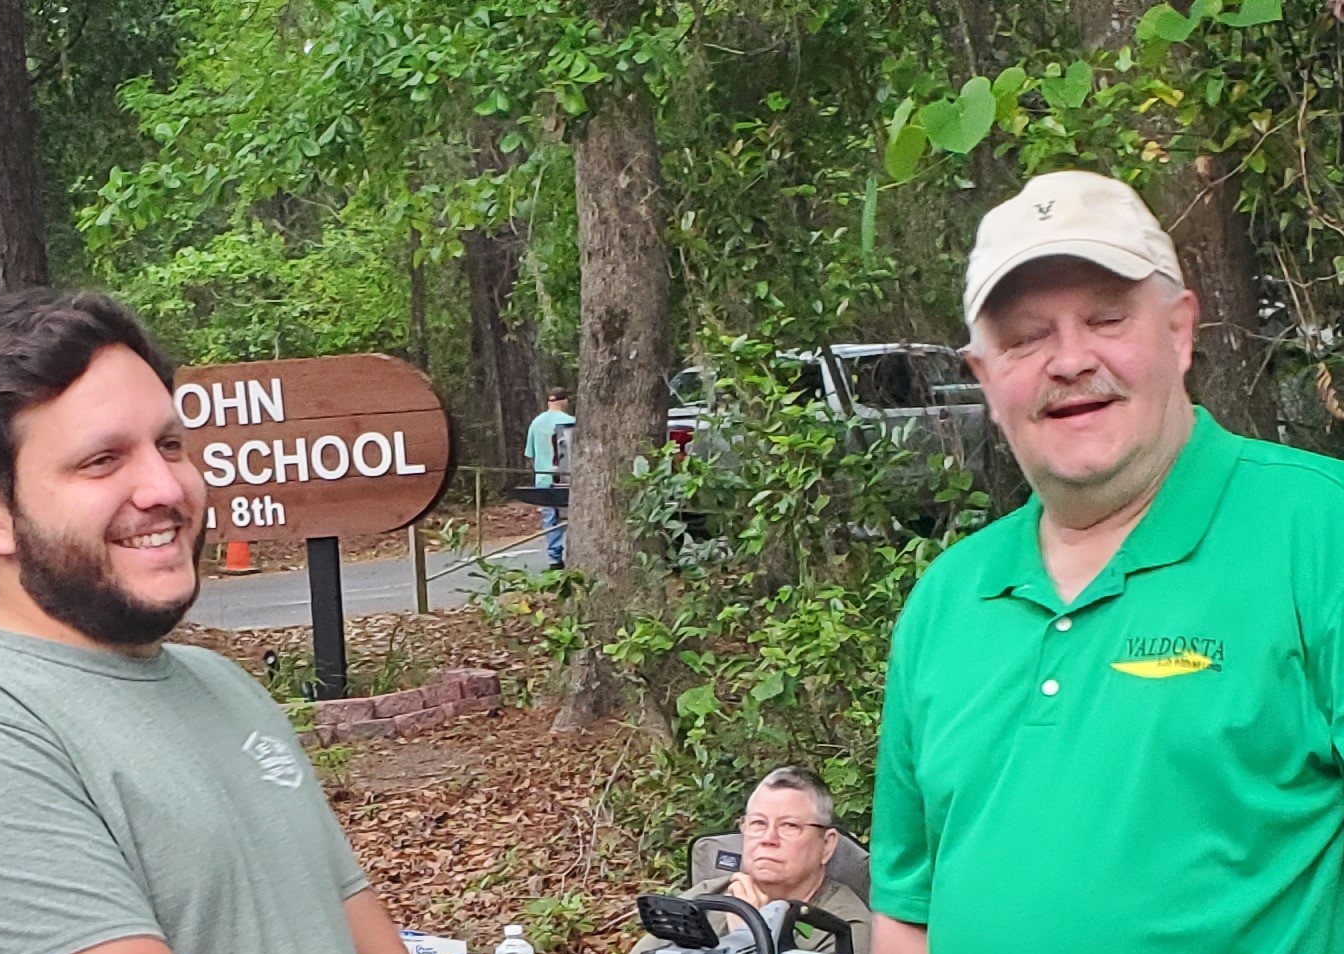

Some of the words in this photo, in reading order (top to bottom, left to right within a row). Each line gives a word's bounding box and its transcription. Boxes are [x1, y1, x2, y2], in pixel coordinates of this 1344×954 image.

[174, 378, 286, 429] OHN
[203, 431, 426, 487] SCHOOL
[231, 495, 286, 528] 8th
[1126, 636, 1225, 661] VALDOSTA
